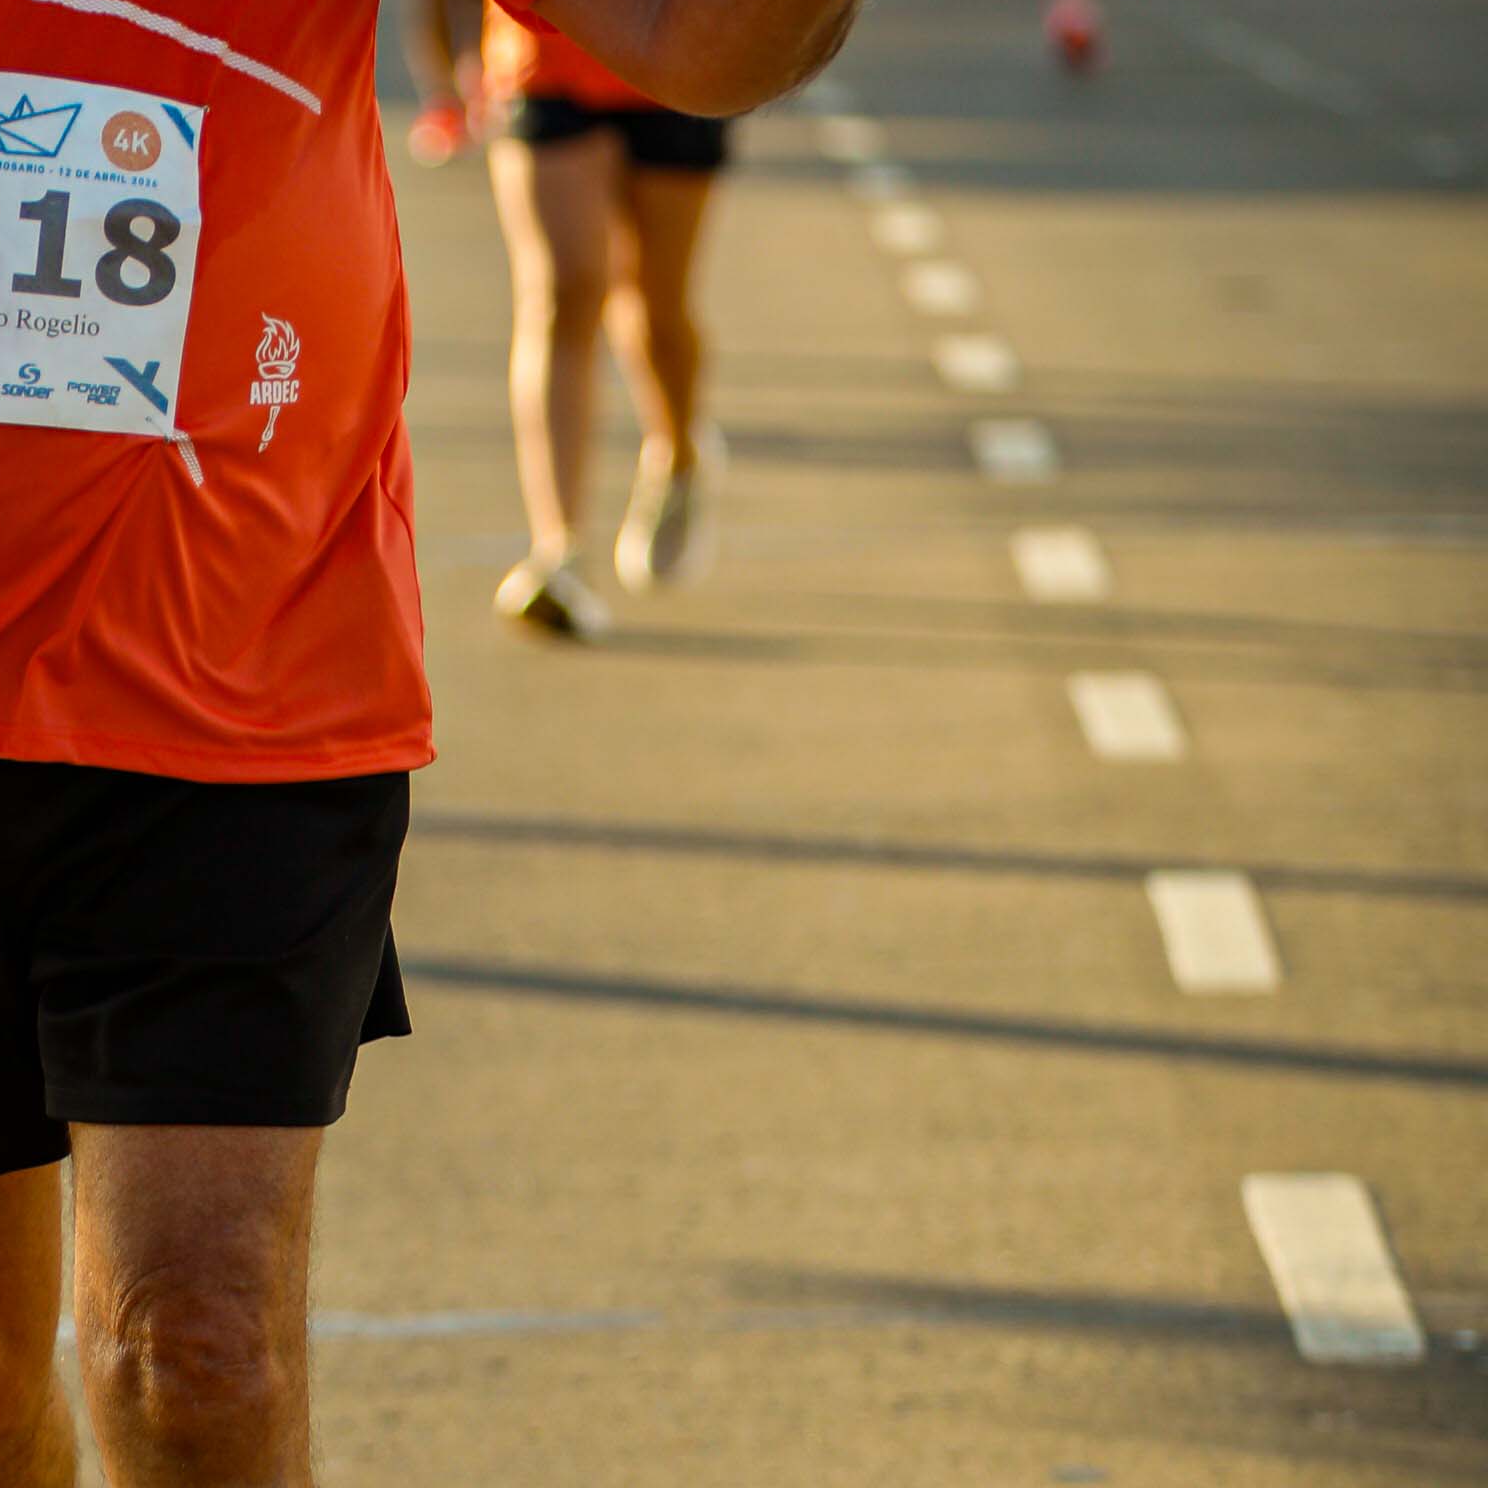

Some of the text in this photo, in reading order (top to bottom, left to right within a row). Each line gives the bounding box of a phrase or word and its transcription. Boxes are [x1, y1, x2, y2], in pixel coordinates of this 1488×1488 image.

[113, 128, 150, 156] 4K
[75, 169, 90, 179] DE
[94, 172, 127, 184] ABRIL
[15, 307, 101, 338] Rogelio
[67, 381, 121, 395] POWER
[250, 379, 300, 405] ARDEC
